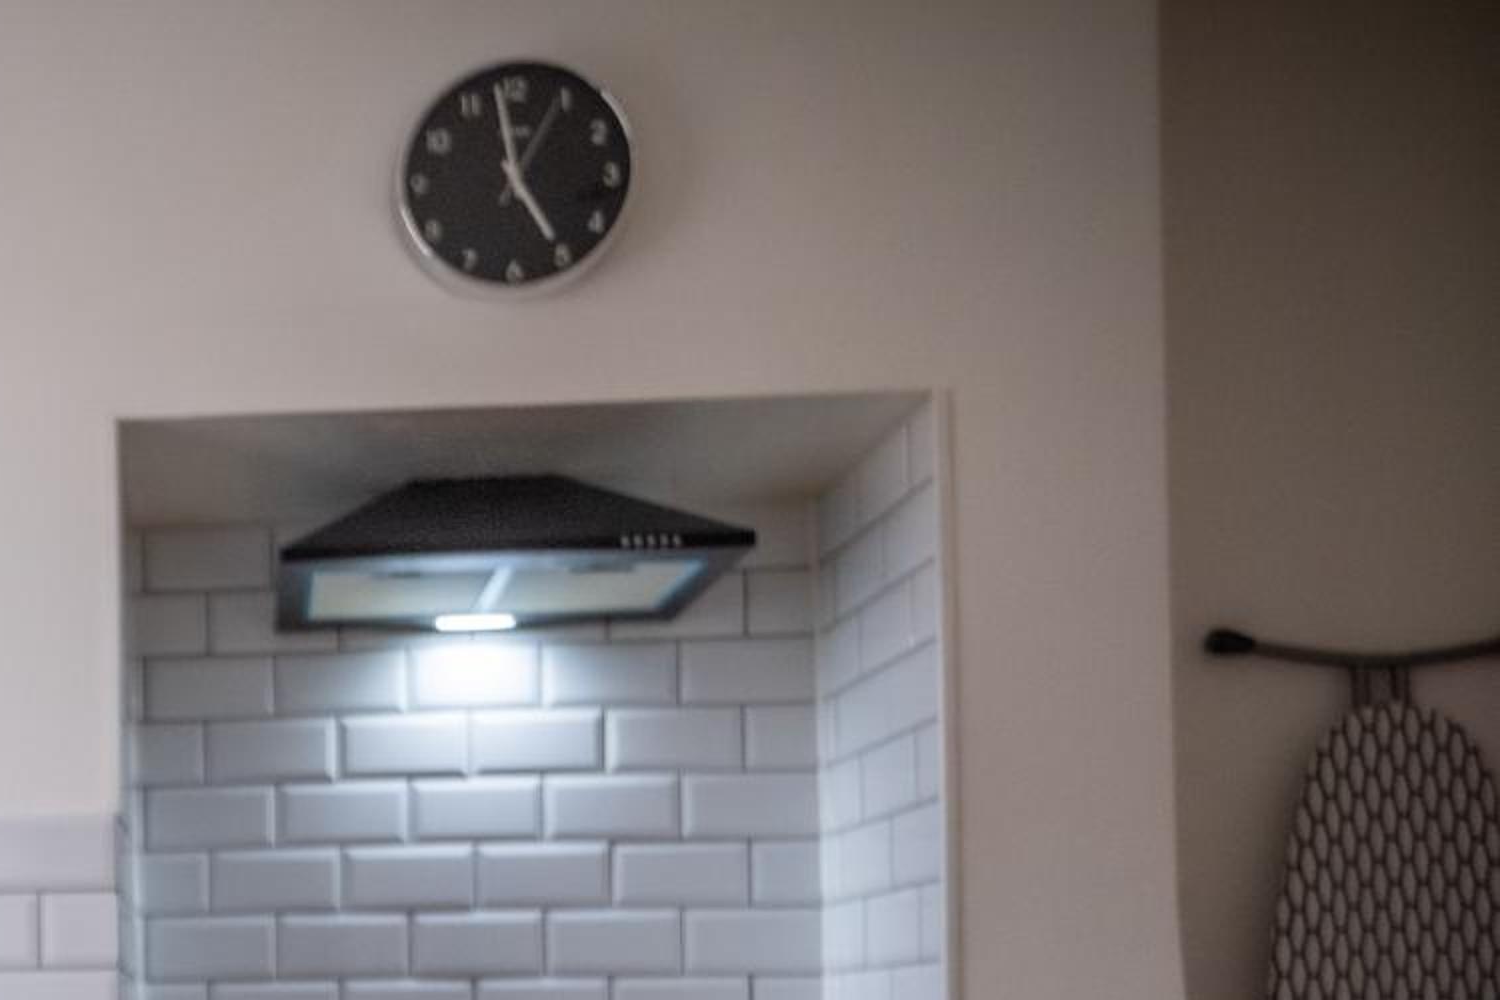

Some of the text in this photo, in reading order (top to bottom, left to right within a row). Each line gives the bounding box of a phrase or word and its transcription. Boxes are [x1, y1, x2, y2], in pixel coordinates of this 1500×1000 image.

[503, 75, 528, 102] 12
[561, 87, 572, 111] 1
[461, 93, 482, 117] 11
[426, 128, 450, 153] 10
[590, 119, 607, 145] 2
[411, 174, 429, 195] 9
[603, 163, 620, 188] 3
[425, 219, 442, 242] 8
[588, 211, 604, 234] 4
[462, 249, 477, 271] 7
[554, 244, 571, 267] 5
[506, 261, 523, 284] 6
